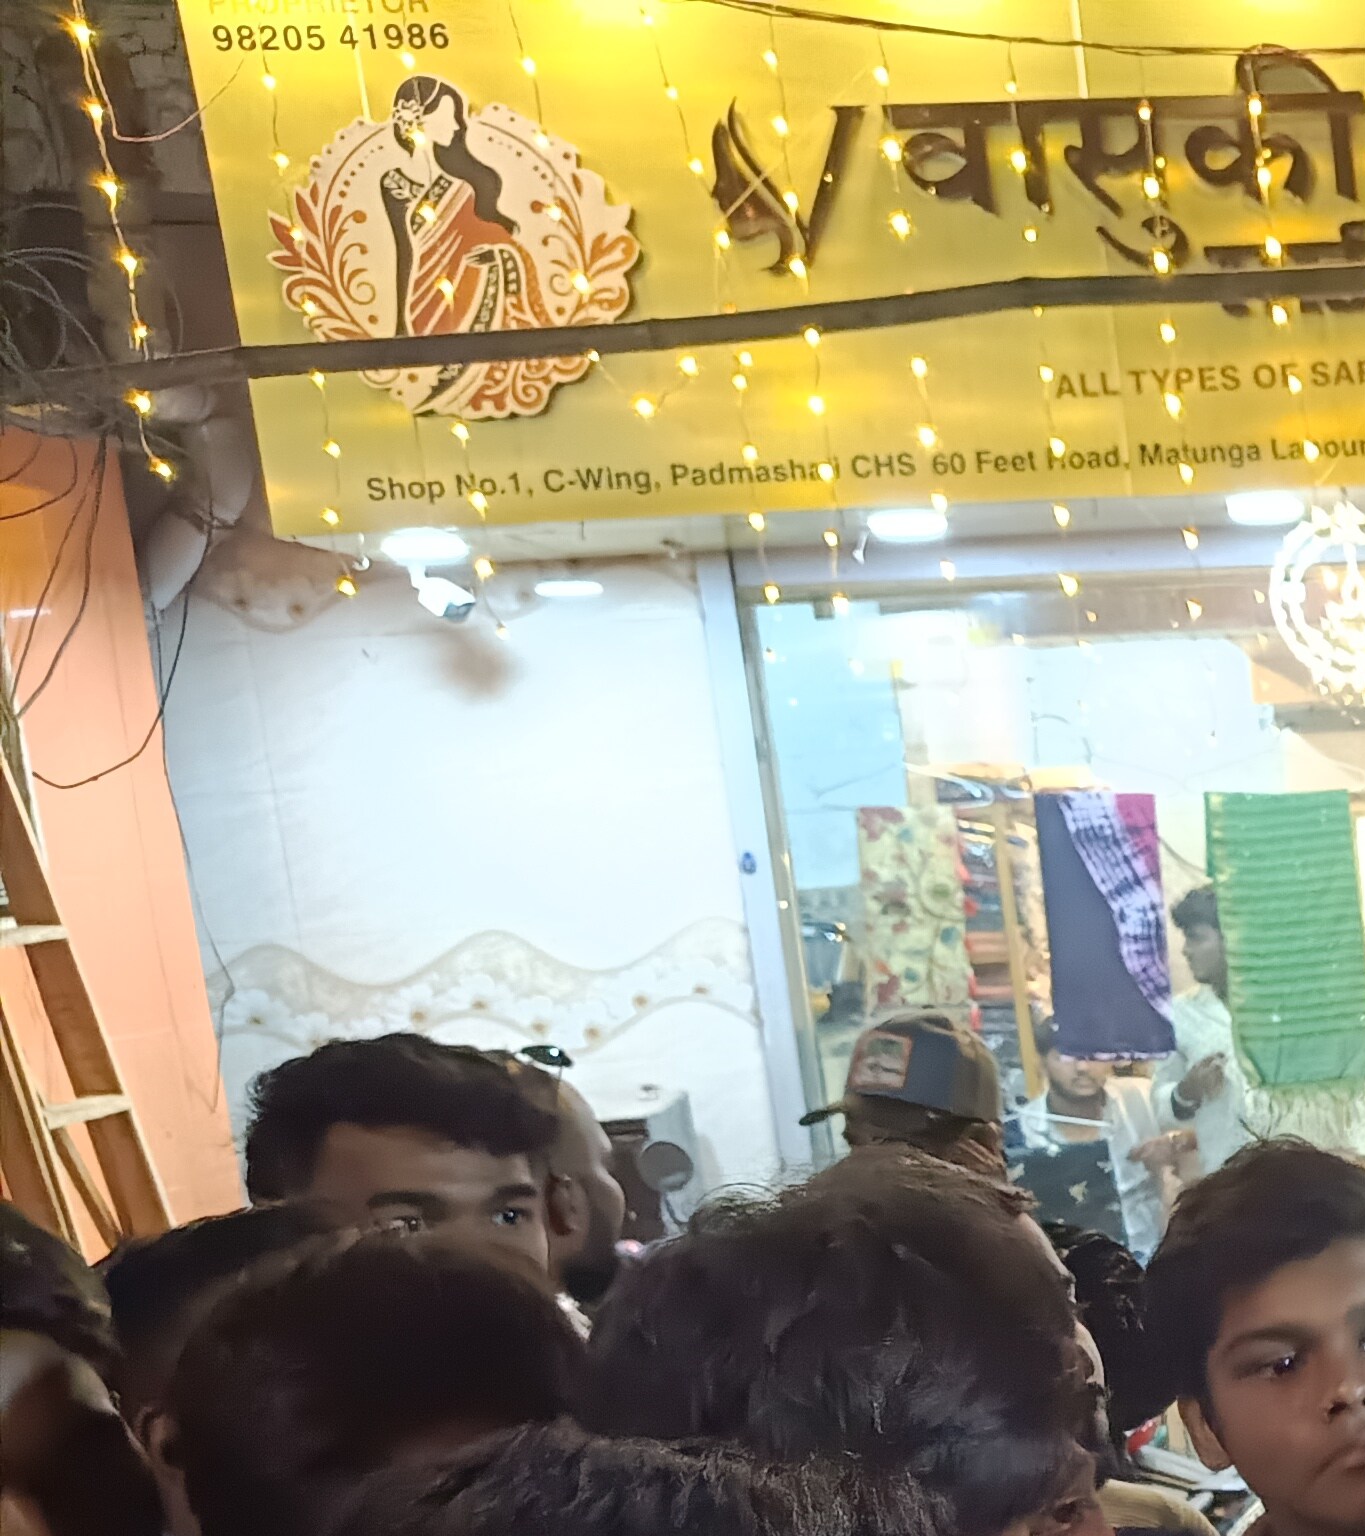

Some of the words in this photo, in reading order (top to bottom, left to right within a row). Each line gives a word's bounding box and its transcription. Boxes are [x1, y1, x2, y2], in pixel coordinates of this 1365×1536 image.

[212, 23, 325, 51] 98205
[339, 22, 450, 51] 41986
[1055, 371, 1122, 399] ALL
[1127, 364, 1241, 395] TYPES
[1253, 363, 1299, 390] OF
[366, 476, 446, 505] Shop
[456, 472, 534, 498] No.1,
[851, 453, 917, 480] CHS
[931, 451, 967, 476] 60
[975, 449, 1037, 475] Feet
[1138, 441, 1261, 469] Matunga
